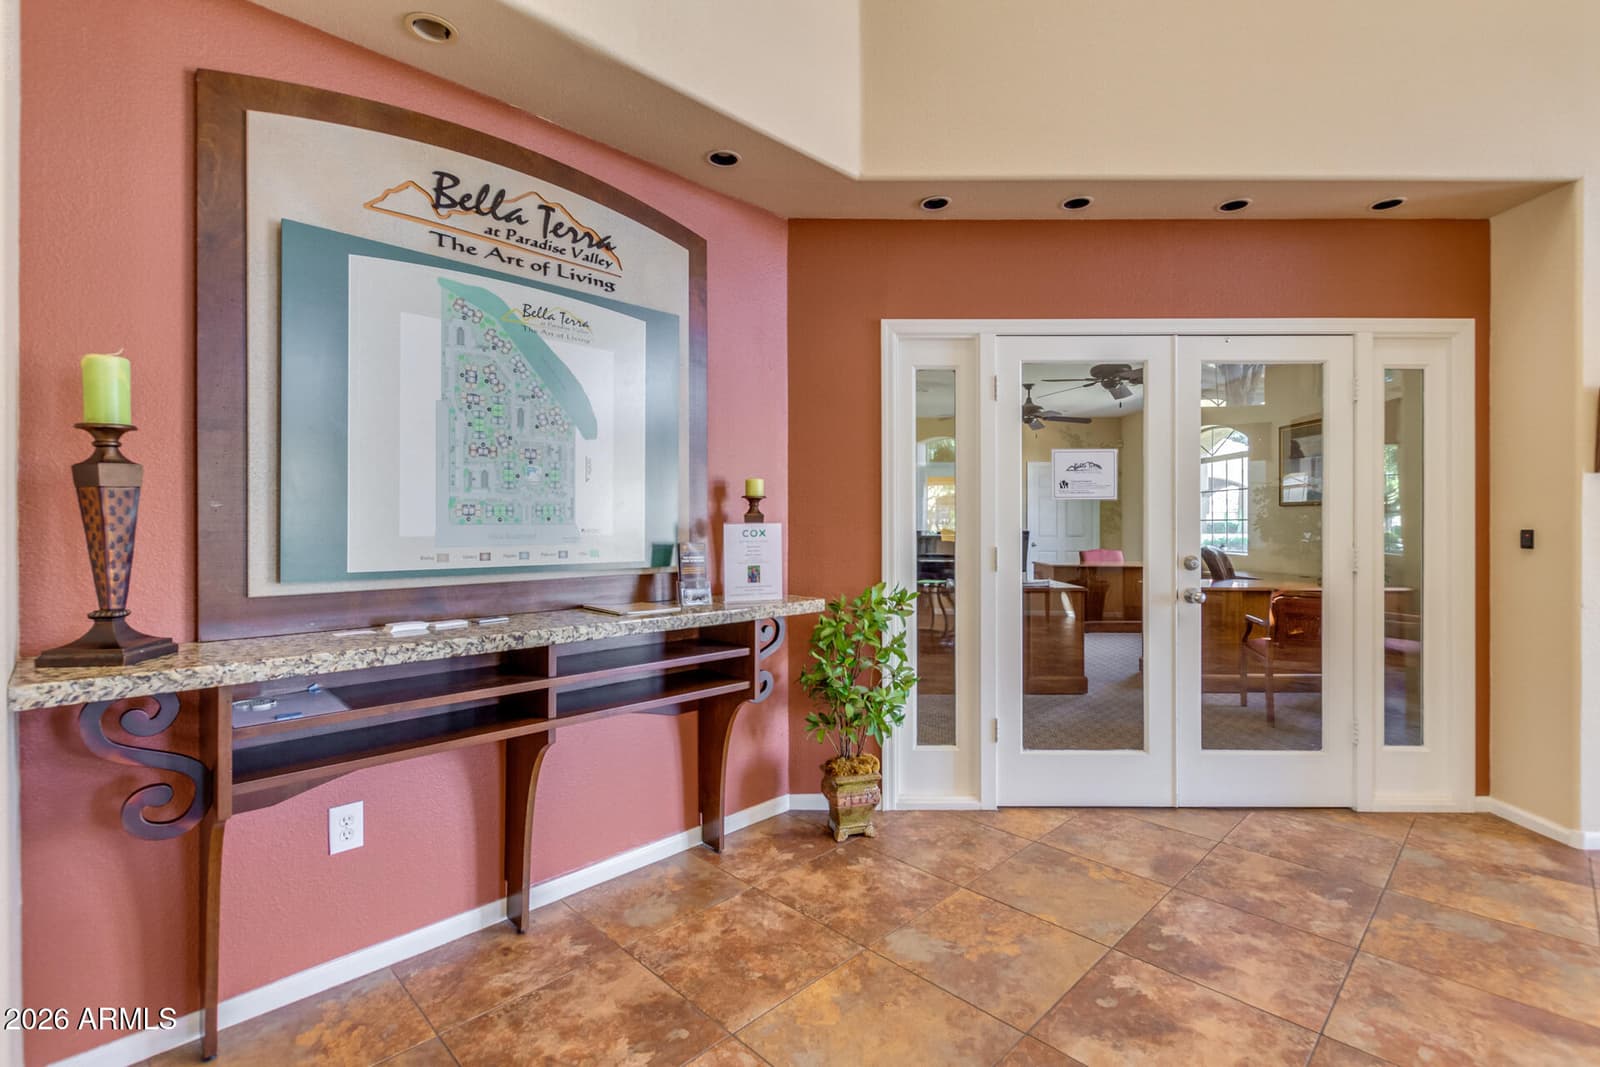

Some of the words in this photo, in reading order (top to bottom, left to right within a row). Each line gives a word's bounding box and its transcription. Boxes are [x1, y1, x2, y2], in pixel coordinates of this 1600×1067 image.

[432, 171, 529, 225] Bella
[537, 204, 617, 251] Terra
[429, 230, 478, 256] The
[484, 246, 525, 268] Art
[530, 260, 551, 277] of
[557, 263, 616, 293] Living
[483, 227, 501, 238] at
[505, 228, 566, 256] Paradise
[571, 246, 613, 270] Valley
[522, 303, 556, 321] Bella
[560, 311, 590, 328] Terra
[742, 528, 767, 538] COX
